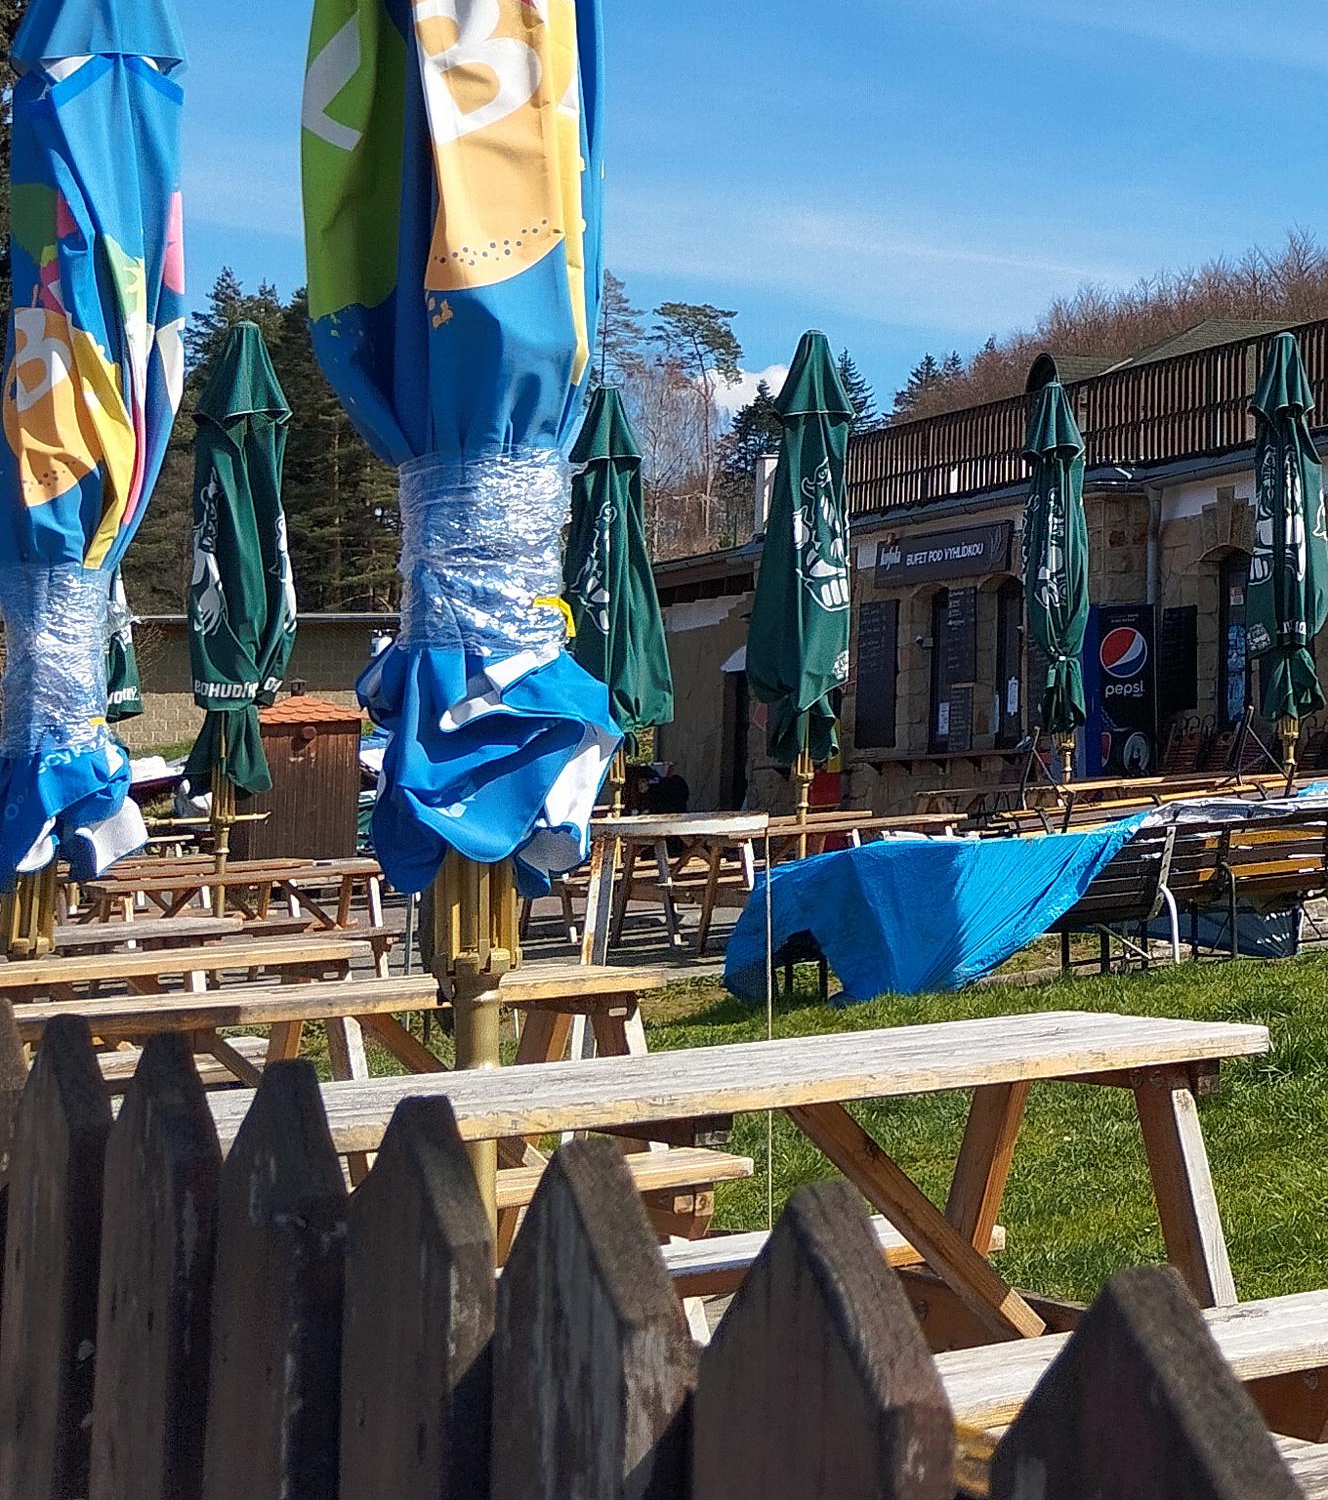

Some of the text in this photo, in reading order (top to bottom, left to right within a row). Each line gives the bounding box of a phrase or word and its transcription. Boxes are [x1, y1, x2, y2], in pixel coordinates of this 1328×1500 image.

[906, 550, 928, 566] BUFET
[928, 549, 943, 563] POD
[1105, 680, 1145, 698] pepsi
